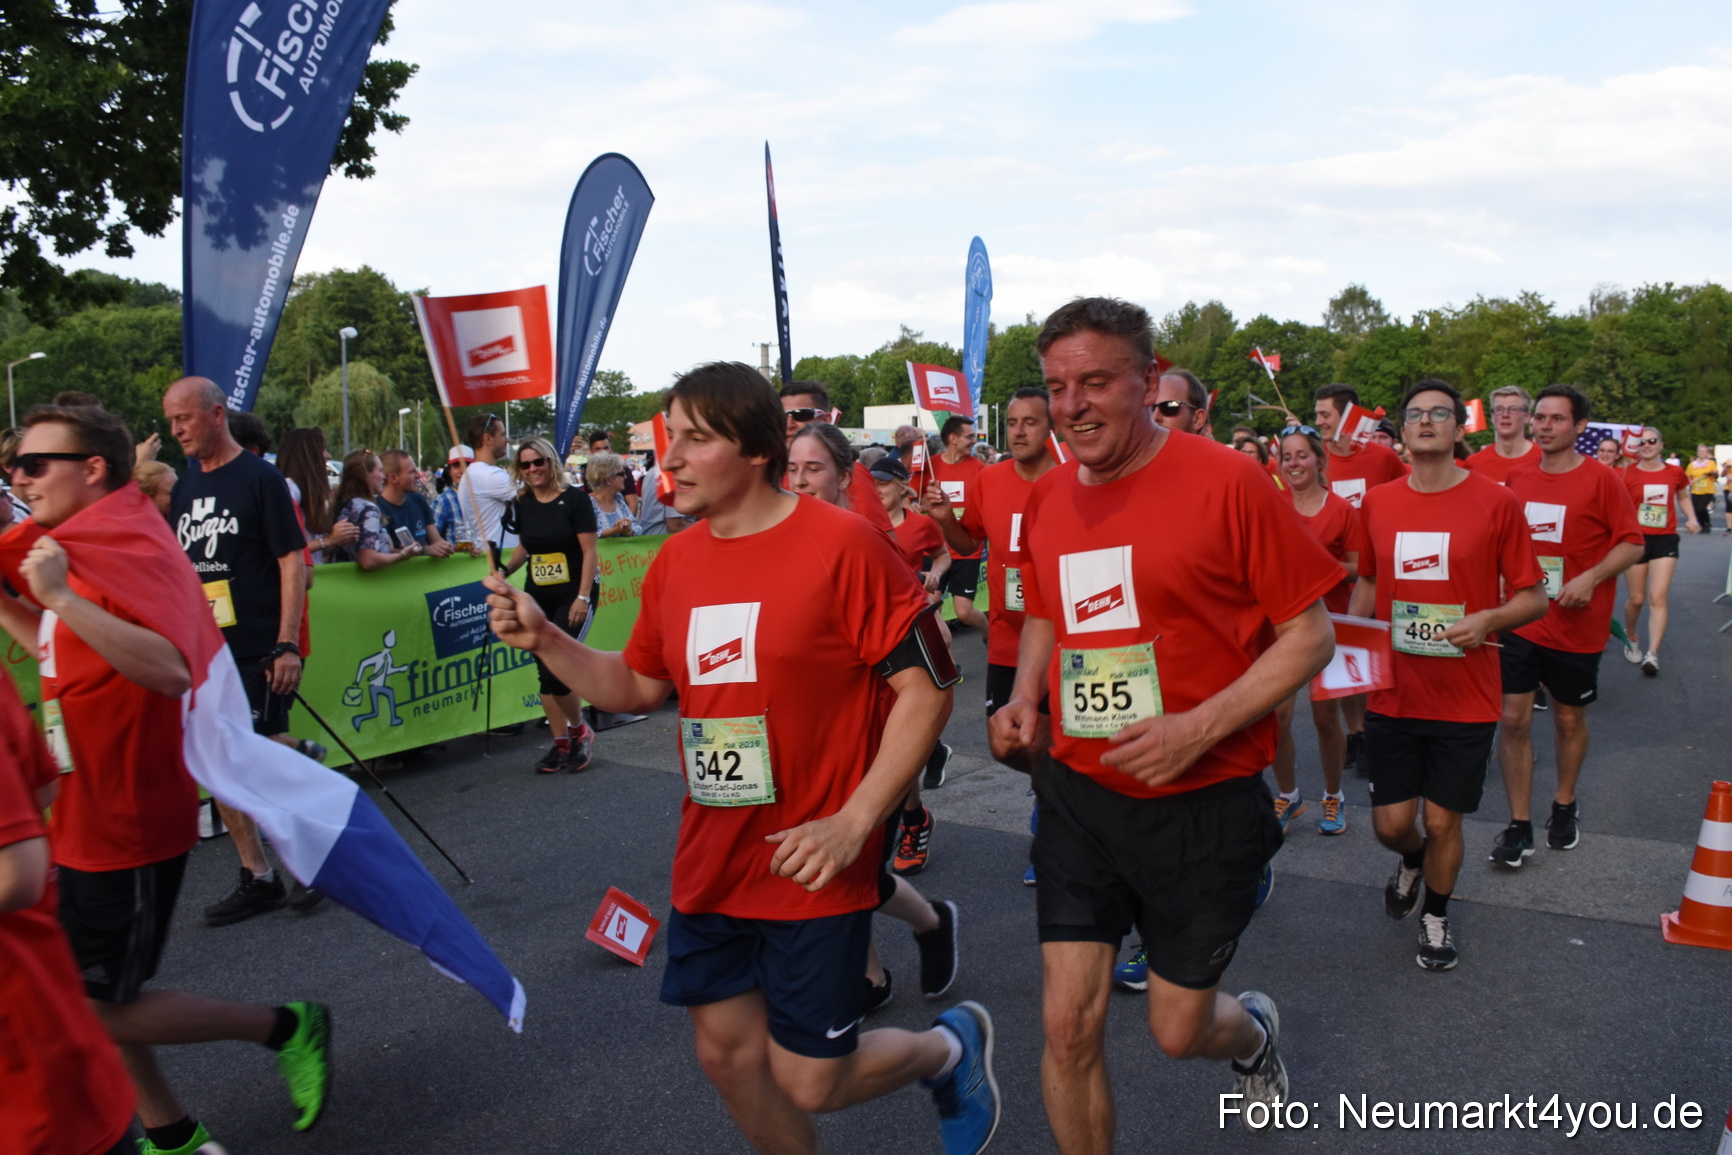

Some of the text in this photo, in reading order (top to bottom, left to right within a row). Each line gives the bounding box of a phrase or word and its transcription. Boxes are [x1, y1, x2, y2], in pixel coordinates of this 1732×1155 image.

[592, 184, 624, 262] Fischer
[604, 199, 629, 262] AUTOMOBILE
[1644, 512, 1661, 522] 538
[177, 508, 239, 559] Burgis
[534, 563, 563, 577] 2024
[444, 602, 489, 622] Fischer
[1087, 593, 1112, 614] DEHN
[449, 613, 488, 628] AUTOMOBILE
[709, 648, 730, 666] DEHN
[413, 683, 484, 718] neumarkt
[1074, 680, 1133, 713] 555
[695, 750, 744, 781] 542
[714, 783, 758, 791] Carl-Jonas
